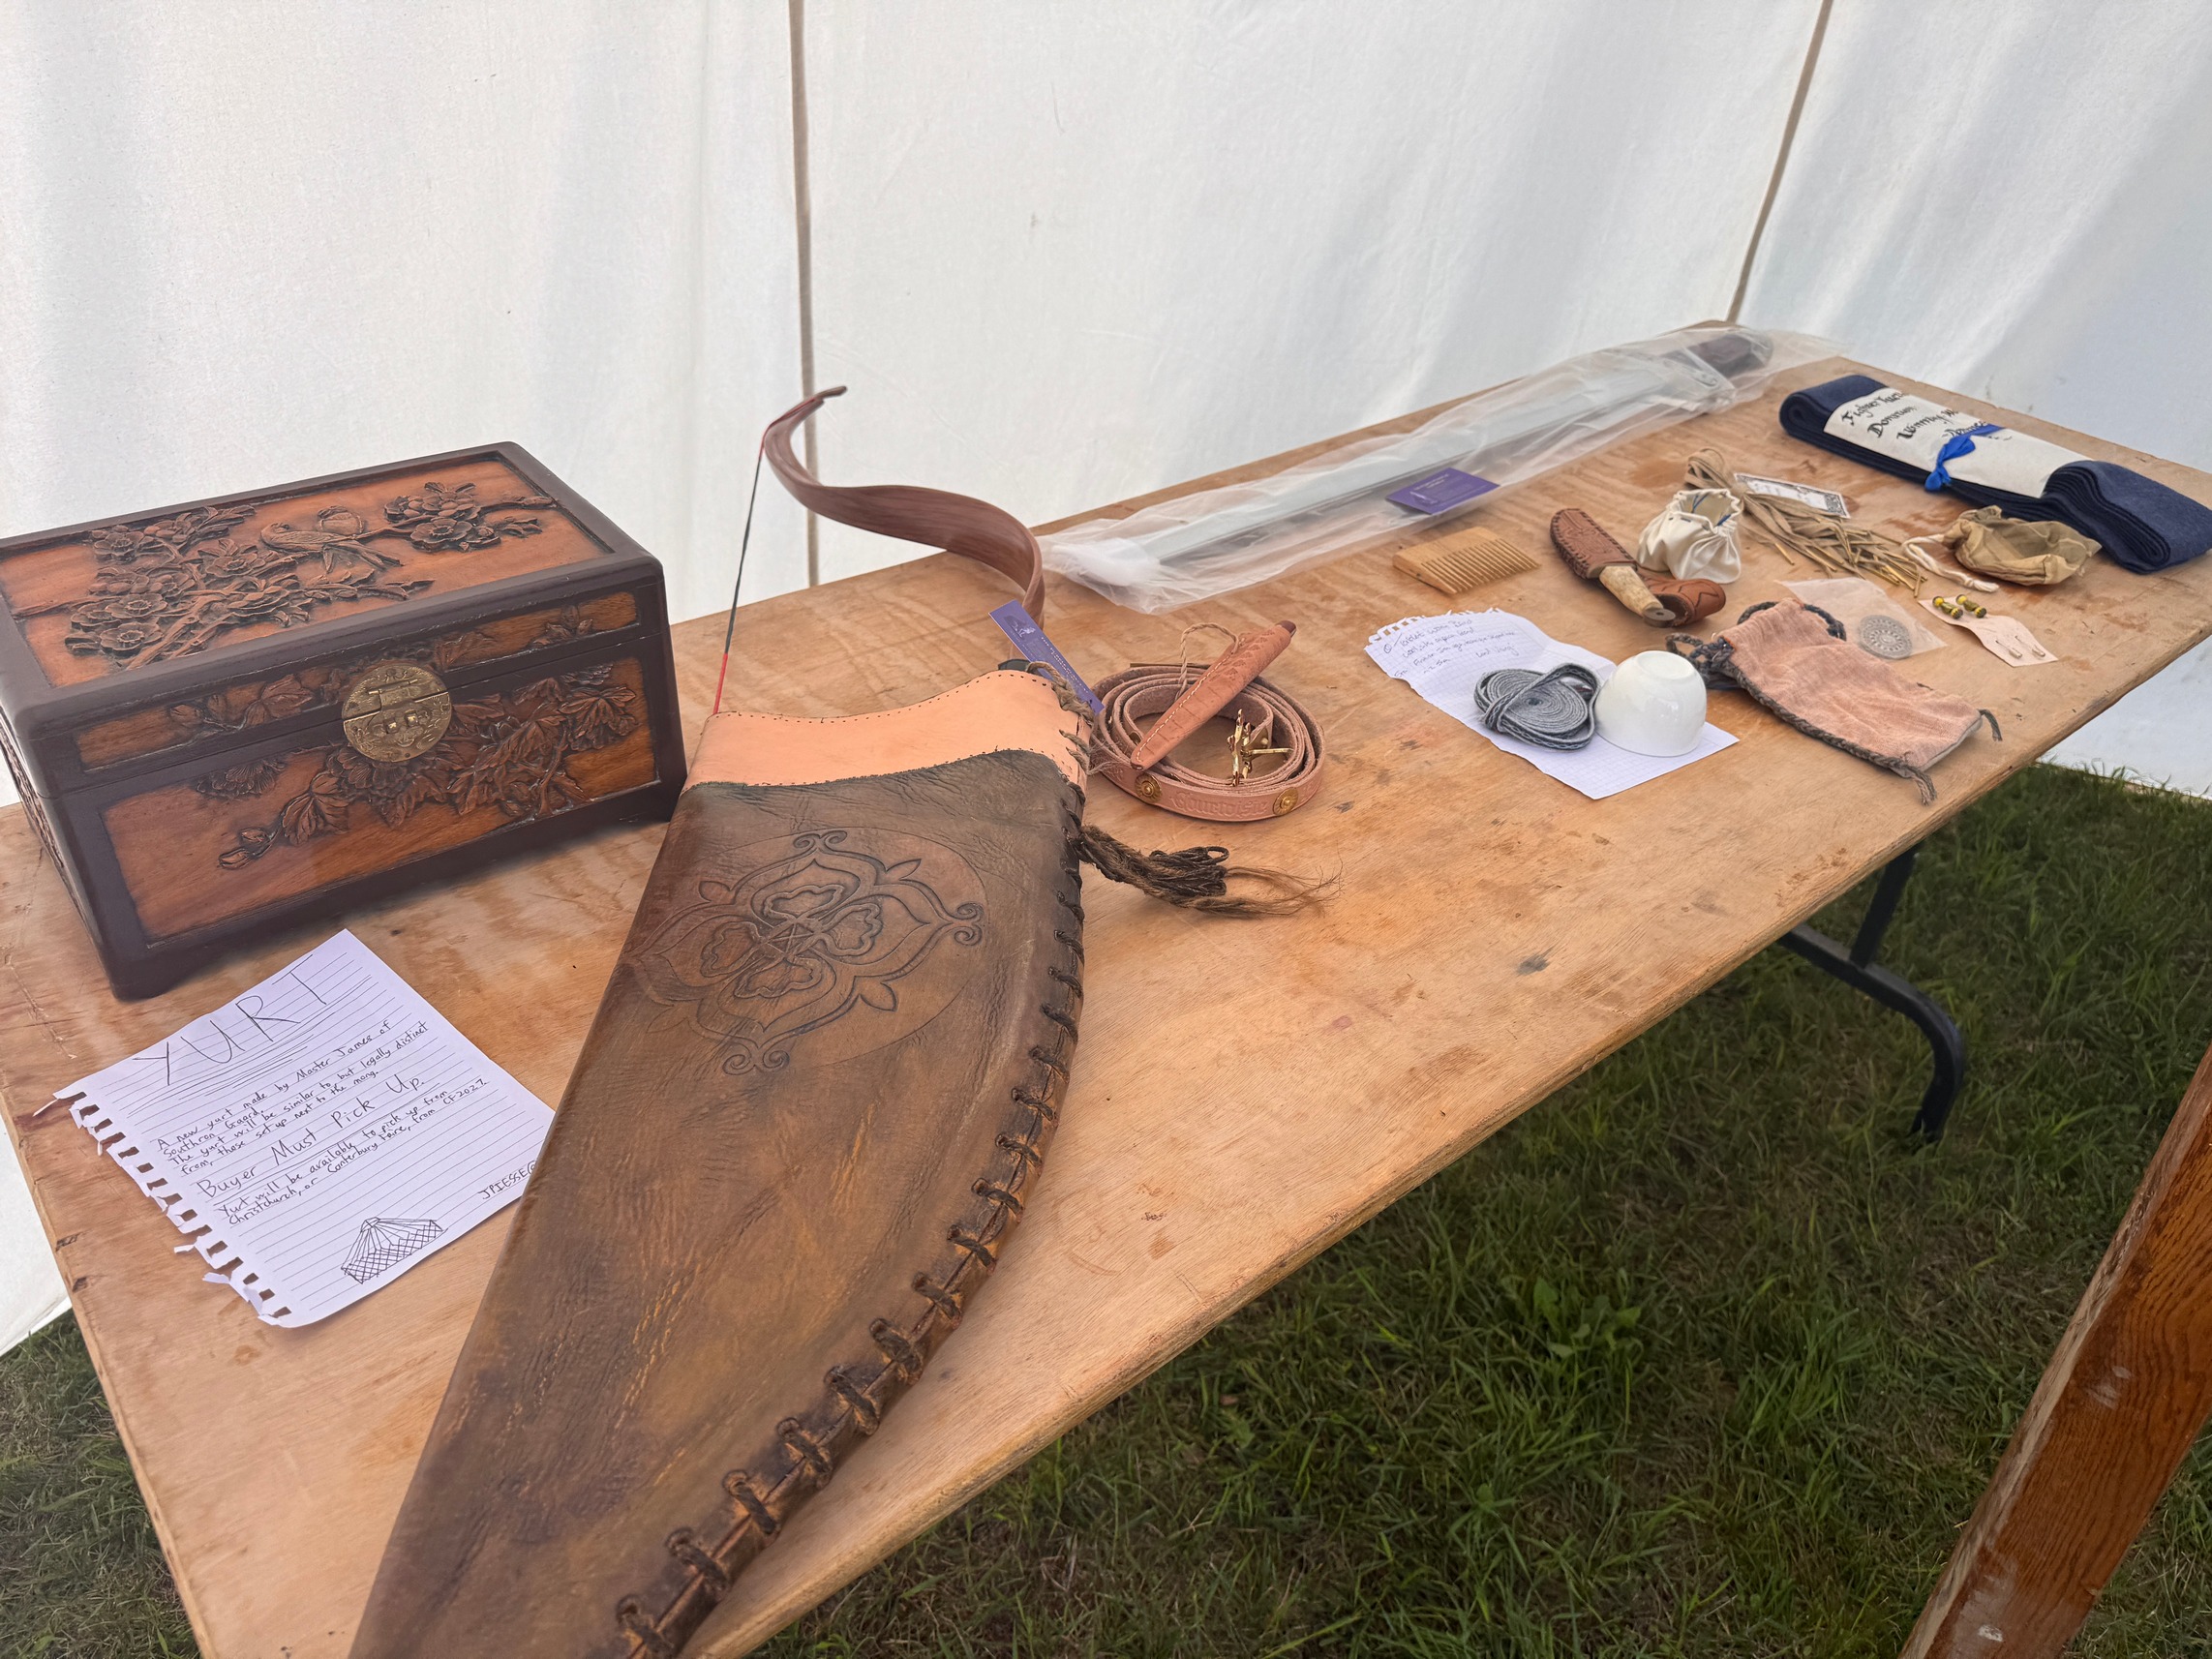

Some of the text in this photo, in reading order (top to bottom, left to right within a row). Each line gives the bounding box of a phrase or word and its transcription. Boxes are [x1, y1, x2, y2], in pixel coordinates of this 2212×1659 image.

[133, 953, 327, 1086] YURT
[158, 1020, 392, 1151] A new yurt made by Master James of
[168, 1020, 429, 1167] The yurt will be similar to but legally distinct
[218, 1140, 246, 1157] those
[256, 1123, 276, 1139] set
[275, 1118, 288, 1129] up
[294, 1102, 314, 1120] next
[316, 1095, 326, 1104] to
[330, 1082, 348, 1096] the
[164, 1133, 215, 1158] Southron
[196, 1164, 258, 1199] Buyer
[270, 1127, 318, 1166] Must
[330, 1097, 376, 1130] Pick
[218, 1090, 448, 1218] Yurt will be available to pick up from
[326, 1141, 379, 1174] Canterbury
